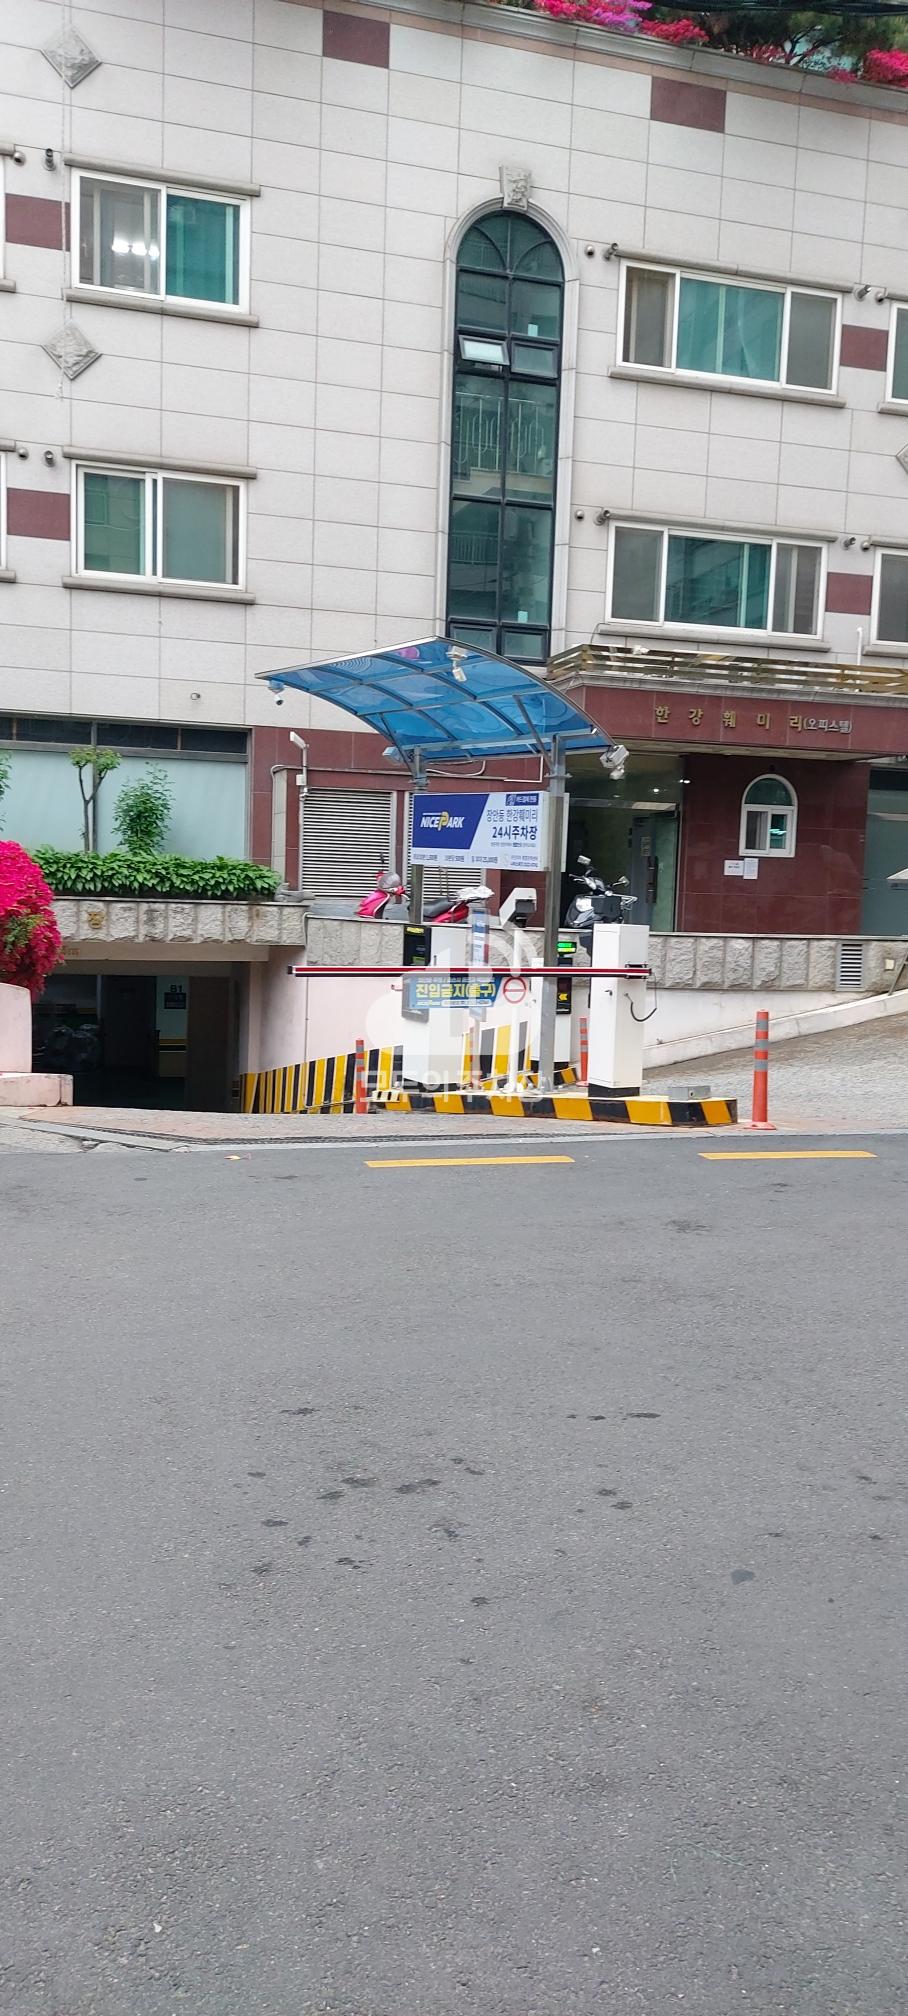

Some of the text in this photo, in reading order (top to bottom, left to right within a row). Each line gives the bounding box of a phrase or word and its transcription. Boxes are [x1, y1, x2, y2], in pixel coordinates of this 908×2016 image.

[487, 808, 505, 822] 장안동
[492, 825, 538, 840] 24시주차장
[415, 983, 496, 998] 진입금지(출구)
